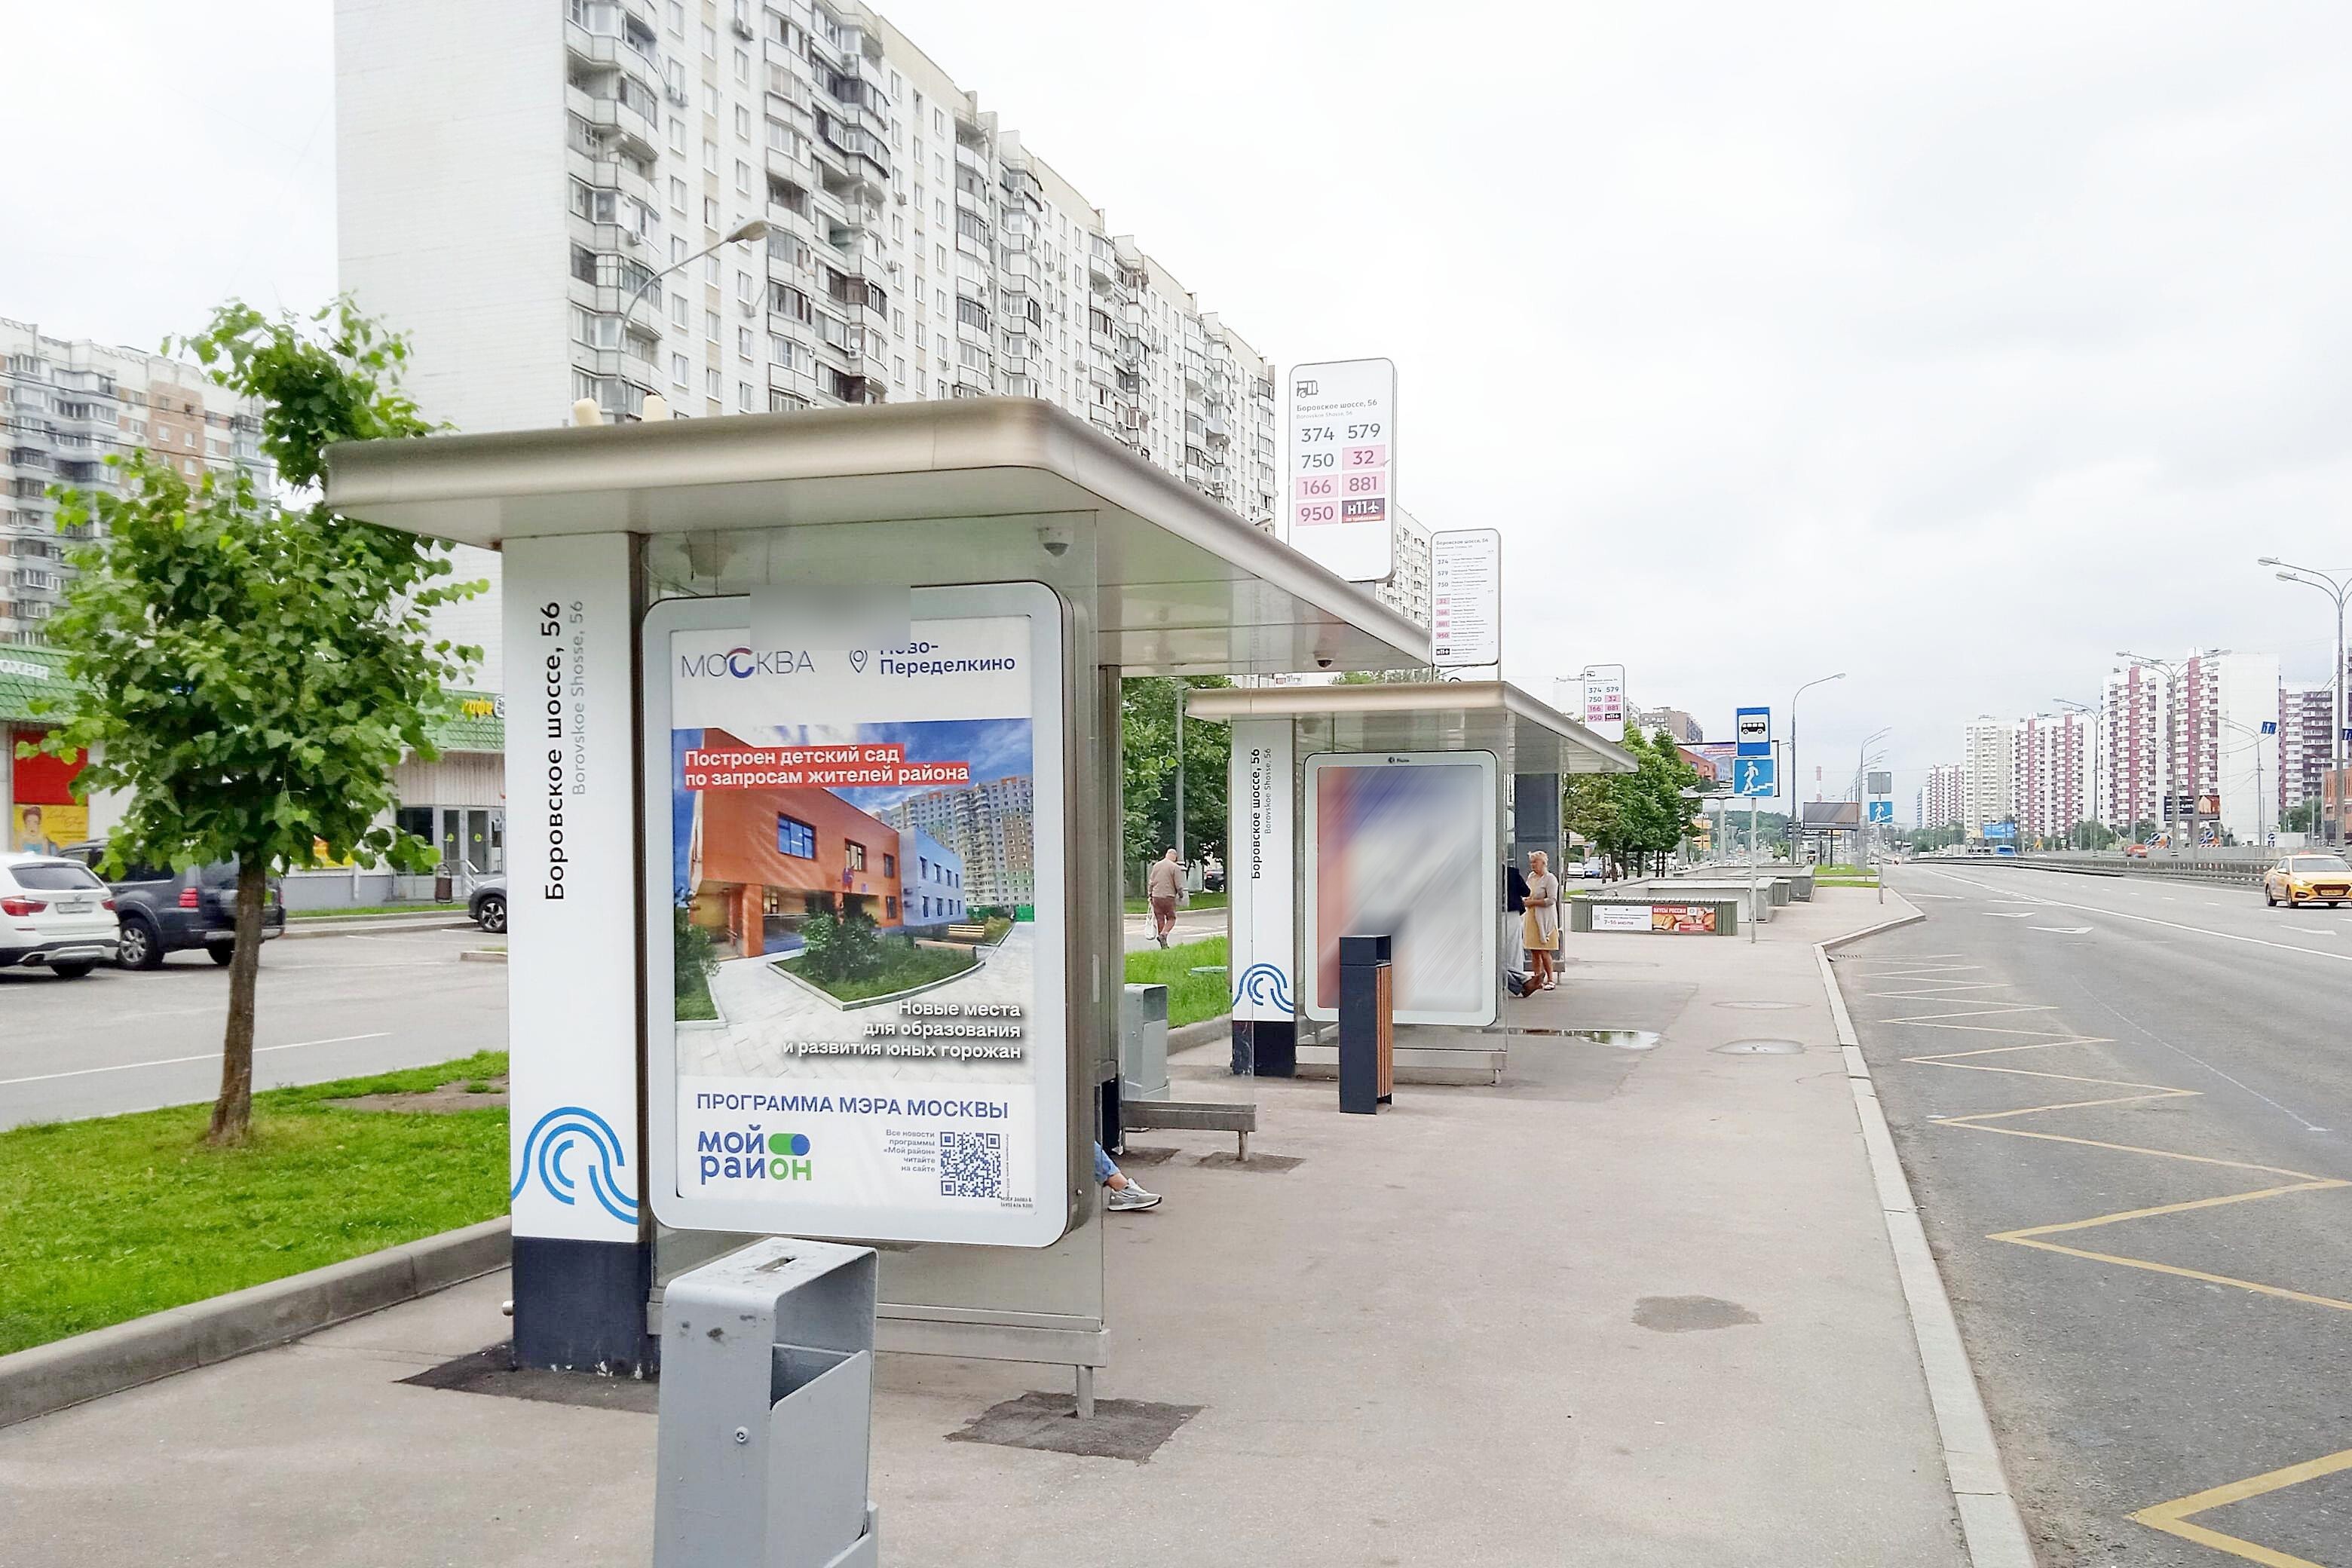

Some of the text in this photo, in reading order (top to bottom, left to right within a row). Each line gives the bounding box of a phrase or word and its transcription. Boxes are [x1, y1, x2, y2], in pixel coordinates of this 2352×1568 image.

[1297, 404, 1338, 412] Боровское
[1301, 427, 1334, 443] 374
[1348, 423, 1380, 439] 579
[1301, 453, 1334, 469] 750
[1353, 450, 1374, 465] 32
[1303, 479, 1331, 495] 166
[1349, 476, 1377, 492] 881
[1301, 506, 1334, 522] 950
[681, 647, 816, 678] МОСКВА
[880, 657, 1015, 678] Переделкино
[570, 601, 586, 795] Borovskoe Shosse, 56
[541, 602, 568, 900] Боровское шоссе, 56
[685, 746, 900, 769] Построен детский сад
[1264, 748, 1272, 758] 56
[685, 764, 969, 789] по запросам жителей района
[1251, 749, 1263, 879] Боровское шоссе, 56
[899, 1000, 1021, 1017] Новые места
[863, 1020, 1021, 1039] для образования
[783, 1042, 1021, 1061] и развития юных горожан
[697, 1093, 1008, 1119] ПРОГРАММА МЭРА МОСКВЫ
[889, 1138, 935, 1147] программы
[903, 1156, 936, 1164] читайте
[912, 1165, 936, 1173] сайте
